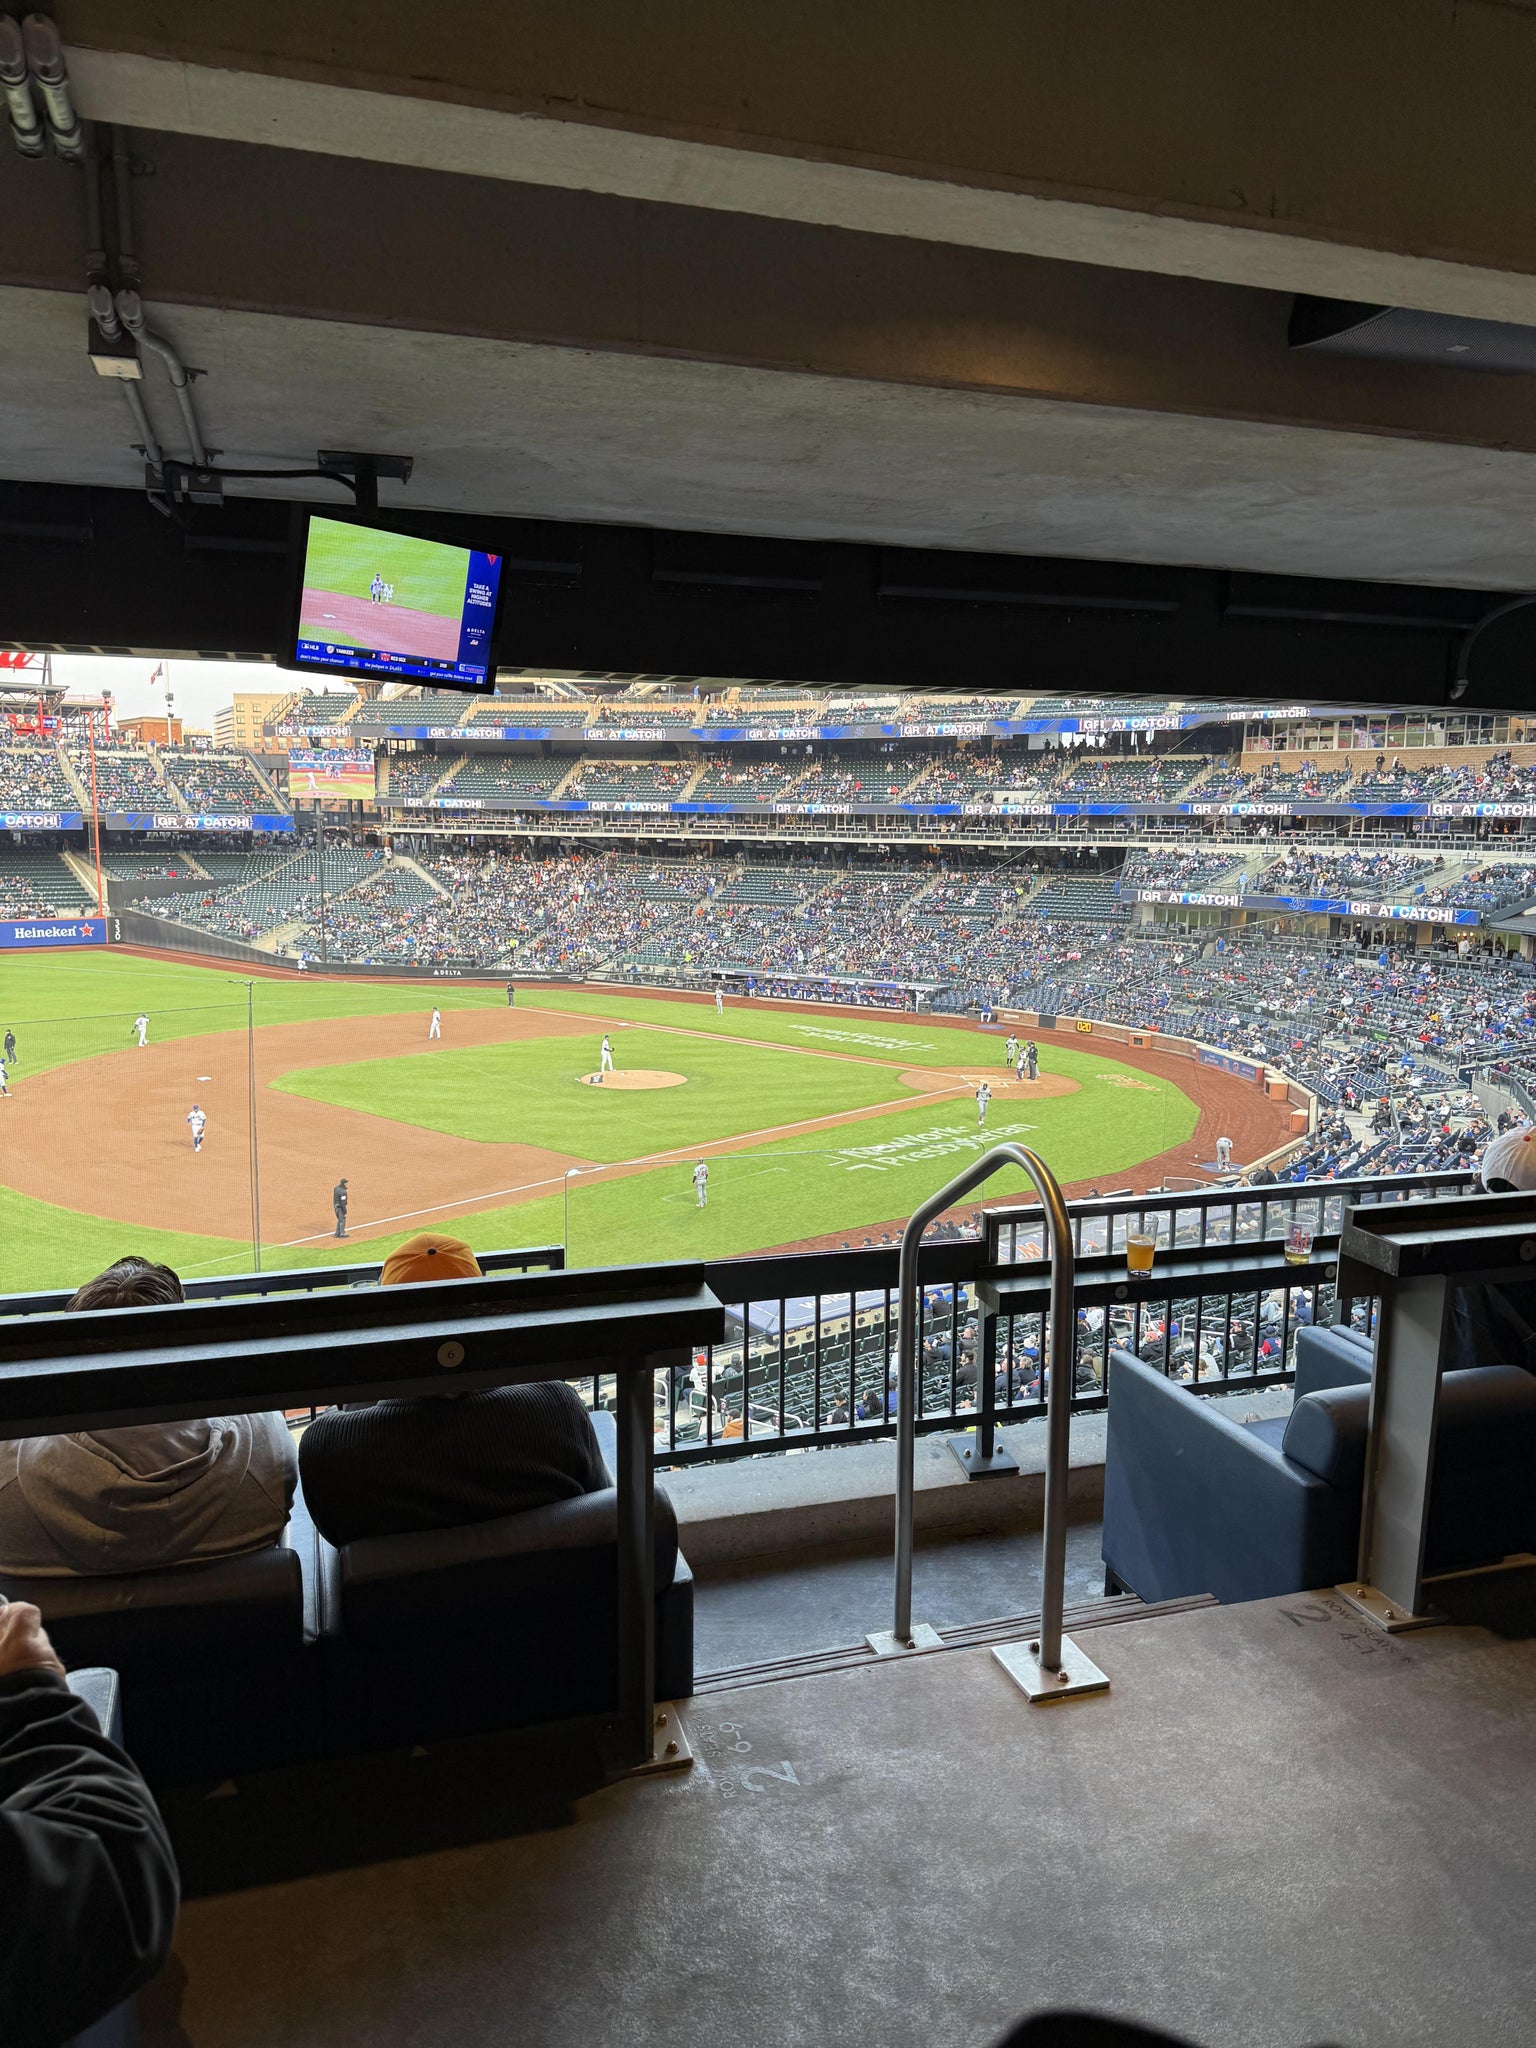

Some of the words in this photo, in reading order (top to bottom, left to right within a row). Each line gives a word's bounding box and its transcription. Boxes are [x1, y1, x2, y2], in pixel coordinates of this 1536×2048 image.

[14, 926, 77, 939] Heineken
[1278, 1604, 1332, 1628] 2
[1321, 1600, 1354, 1621] ROW
[1360, 1626, 1398, 1654] SEATS
[698, 1724, 721, 1757] SEATS
[719, 1722, 752, 1753] 6-9
[715, 1768, 738, 1799] ROW
[740, 1760, 800, 1793] 2
